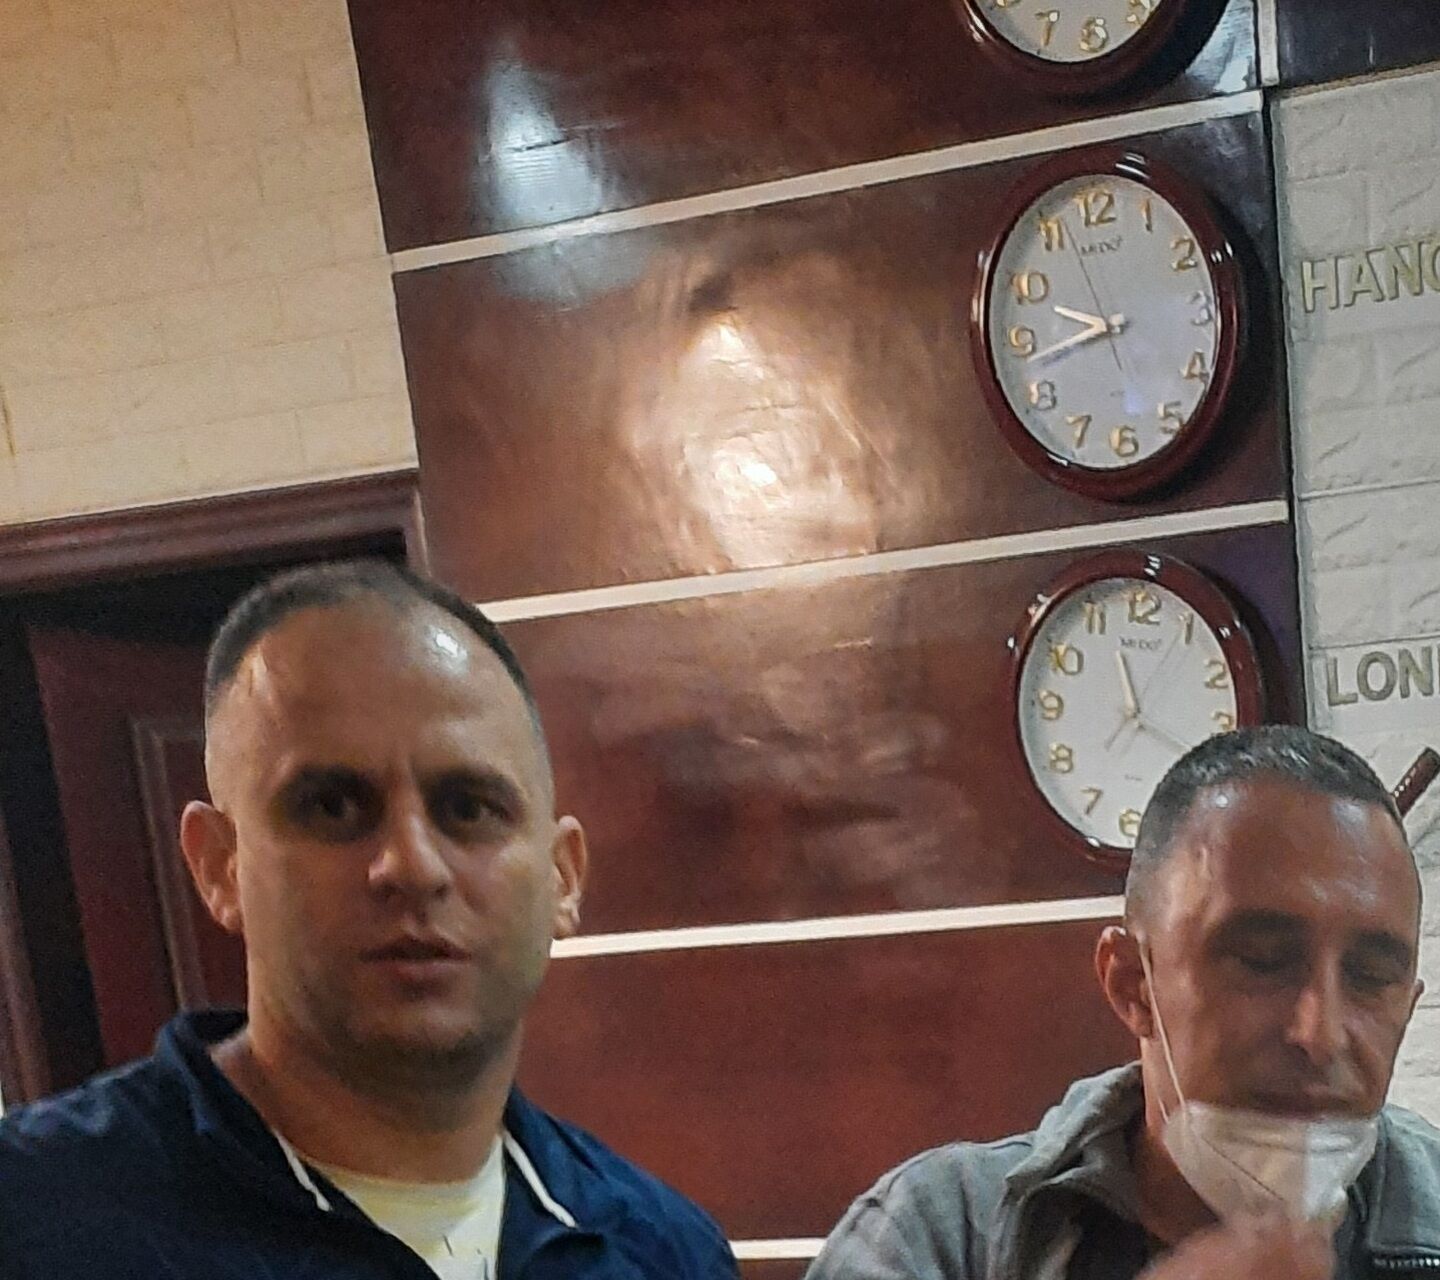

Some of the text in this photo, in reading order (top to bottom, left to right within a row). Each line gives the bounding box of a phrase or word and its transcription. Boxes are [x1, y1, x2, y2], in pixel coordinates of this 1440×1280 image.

[1034, 10, 1060, 47] 7
[1079, 16, 1109, 51] 6
[1073, 188, 1117, 228] 12
[1138, 198, 1153, 234] 1
[1039, 217, 1065, 253] 11
[1169, 235, 1198, 271] 2
[1010, 271, 1049, 304] 10
[1190, 290, 1212, 326] 3
[1008, 325, 1035, 357] 9
[1180, 349, 1210, 386] 4
[1029, 380, 1057, 411] 8
[1066, 414, 1092, 448] 7
[1157, 401, 1185, 435] 5
[1109, 424, 1139, 458] 6
[1085, 602, 1107, 635] 11
[1127, 590, 1162, 626] 12
[1178, 610, 1196, 645] 1
[1052, 643, 1086, 676] 10
[1204, 657, 1230, 689] 2
[1037, 689, 1065, 721] 9
[1050, 744, 1074, 774] 8
[1082, 786, 1105, 816] 7
[1118, 809, 1143, 838] 6
